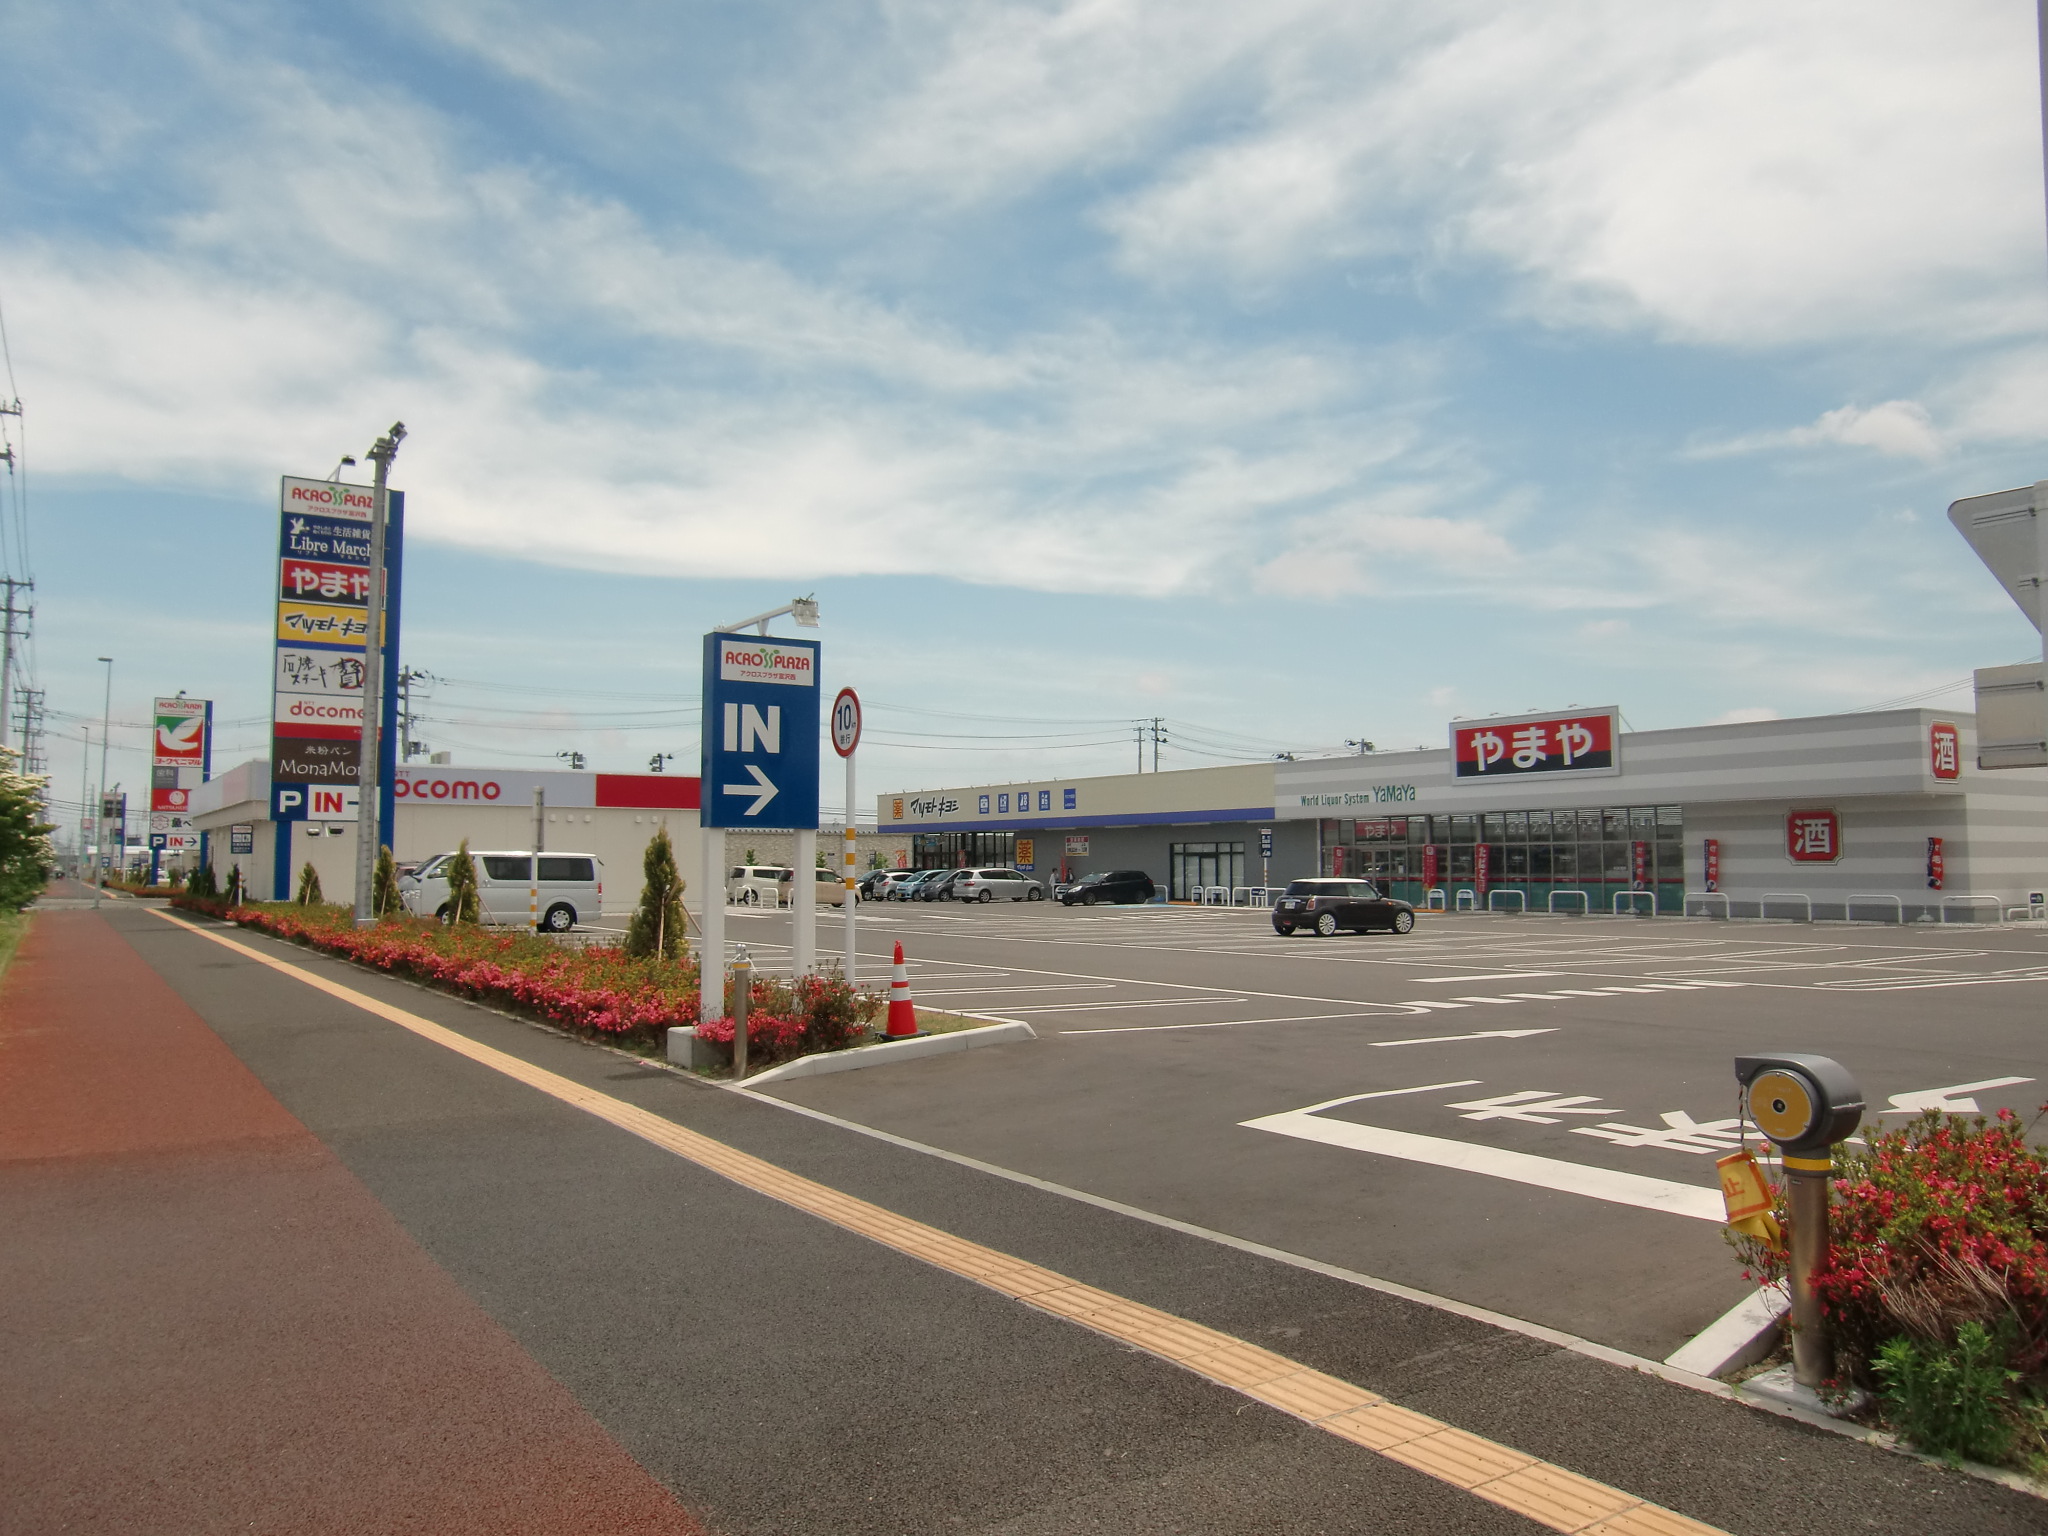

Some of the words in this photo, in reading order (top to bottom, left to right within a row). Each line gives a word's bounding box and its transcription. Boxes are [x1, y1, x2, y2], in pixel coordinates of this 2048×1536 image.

[290, 536, 328, 552] Libre
[291, 567, 370, 600] やまや
[285, 613, 368, 637] マツモトキヨ
[284, 654, 316, 673] 石焼
[291, 666, 327, 688] ステーキ
[723, 703, 780, 754] IN
[837, 704, 851, 730] 10
[1471, 723, 1592, 771] やまや
[1934, 732, 1955, 771] 酒
[155, 757, 202, 766] ヨークベニマル
[395, 779, 500, 800] ocomo
[1300, 795, 1319, 806] World
[1321, 794, 1342, 807] Liquor
[1344, 793, 1369, 806] System
[1372, 784, 1415, 803] YaMaYa
[279, 790, 302, 813] P
[314, 791, 343, 813] IN
[910, 796, 959, 818] マツモトキヨシ
[153, 836, 164, 847] P
[169, 837, 183, 847] IN
[1364, 824, 1397, 839] やまや
[1794, 818, 1831, 854] 酒
[1018, 840, 1032, 863] 薬
